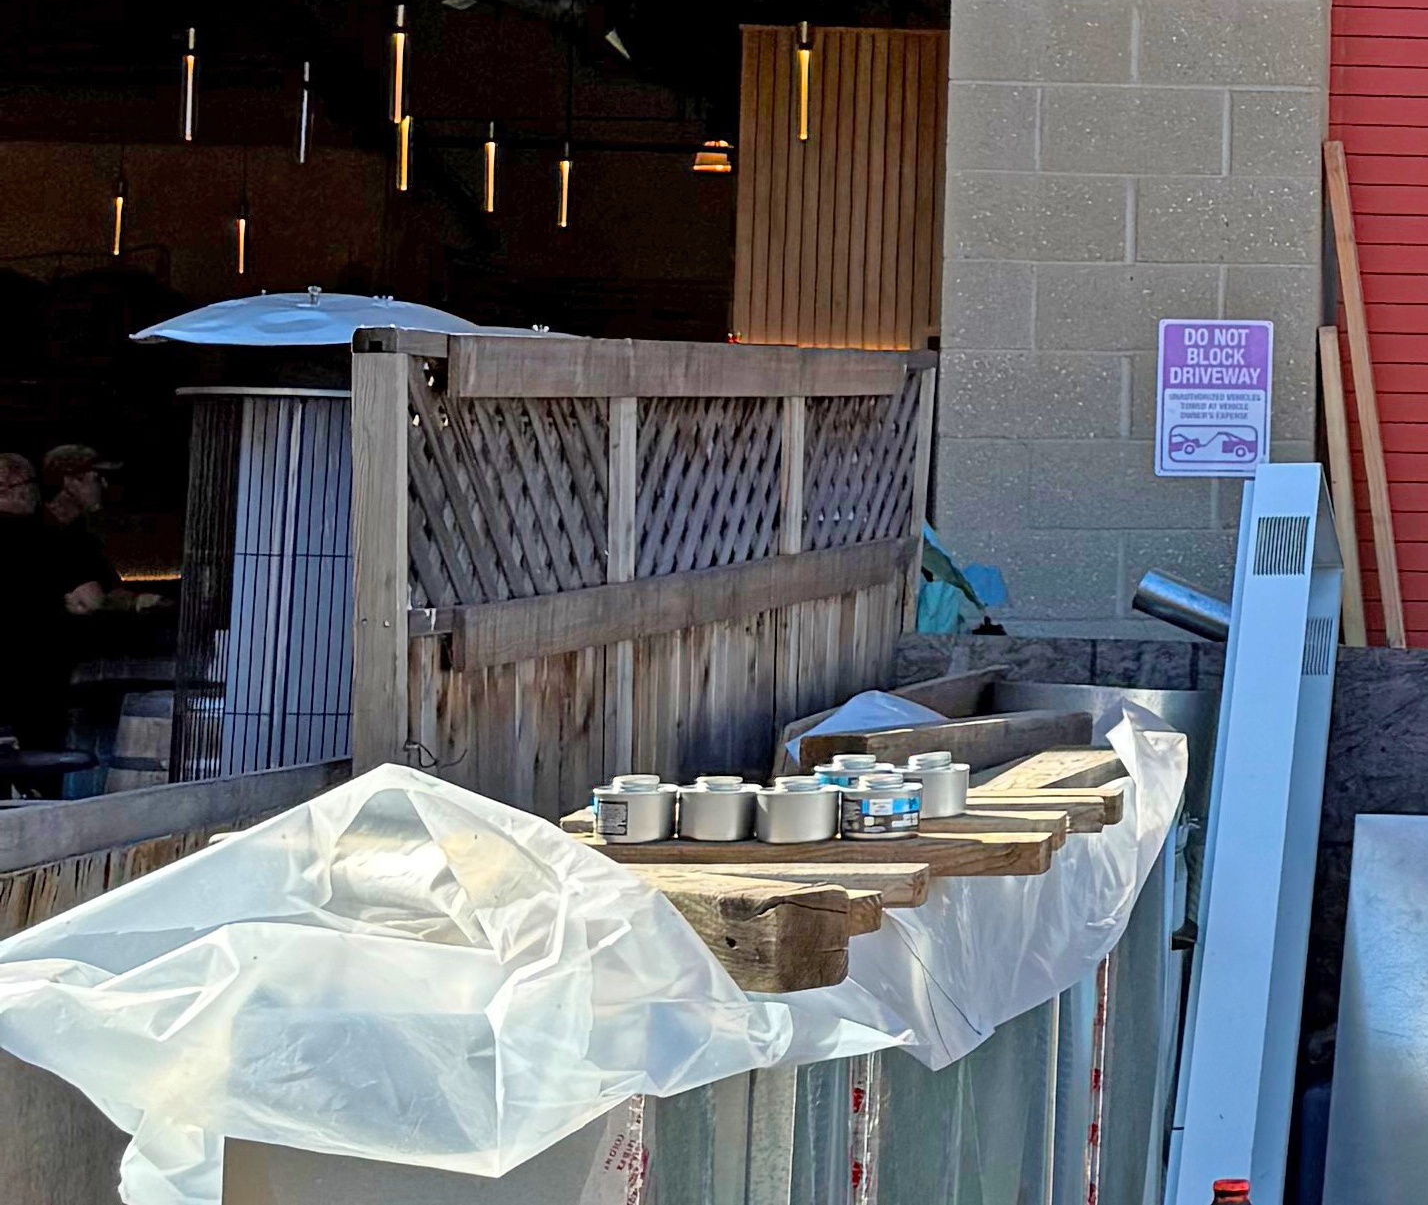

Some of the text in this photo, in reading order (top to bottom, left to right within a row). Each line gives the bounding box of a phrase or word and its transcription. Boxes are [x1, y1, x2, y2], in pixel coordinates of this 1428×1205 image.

[1184, 328, 1250, 346] DO NOT
[1187, 348, 1245, 366] BLOCK
[1169, 367, 1261, 385] DRIVEWAY
